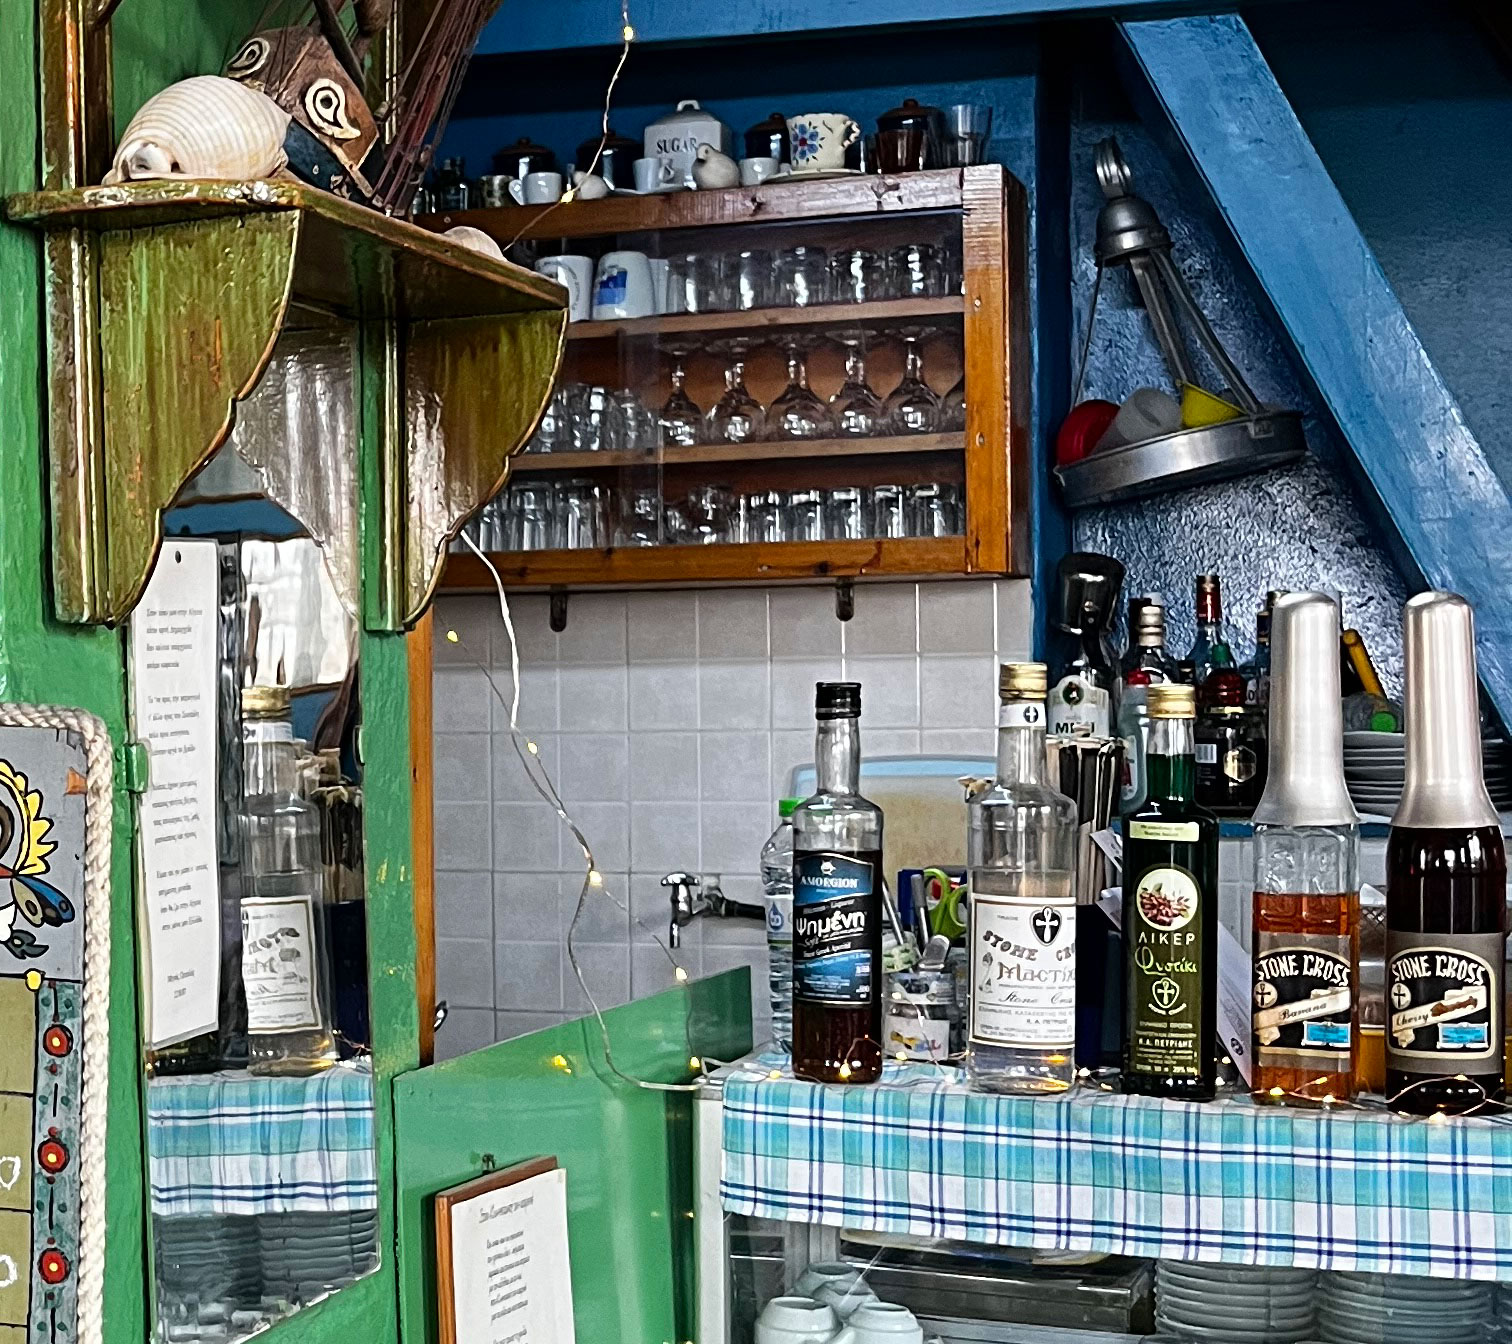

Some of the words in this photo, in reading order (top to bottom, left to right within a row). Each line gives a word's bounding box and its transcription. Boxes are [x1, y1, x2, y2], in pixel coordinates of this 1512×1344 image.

[656, 137, 697, 154] SUGAR
[799, 875, 859, 889] AMORGION
[795, 910, 866, 939] Ψημένη
[1138, 931, 1196, 946] ΛΙΚΕΡ
[1254, 954, 1300, 981] STONE
[1302, 954, 1351, 987] CROSS
[1391, 955, 1432, 982] STONE
[1435, 954, 1486, 986] CROSS
